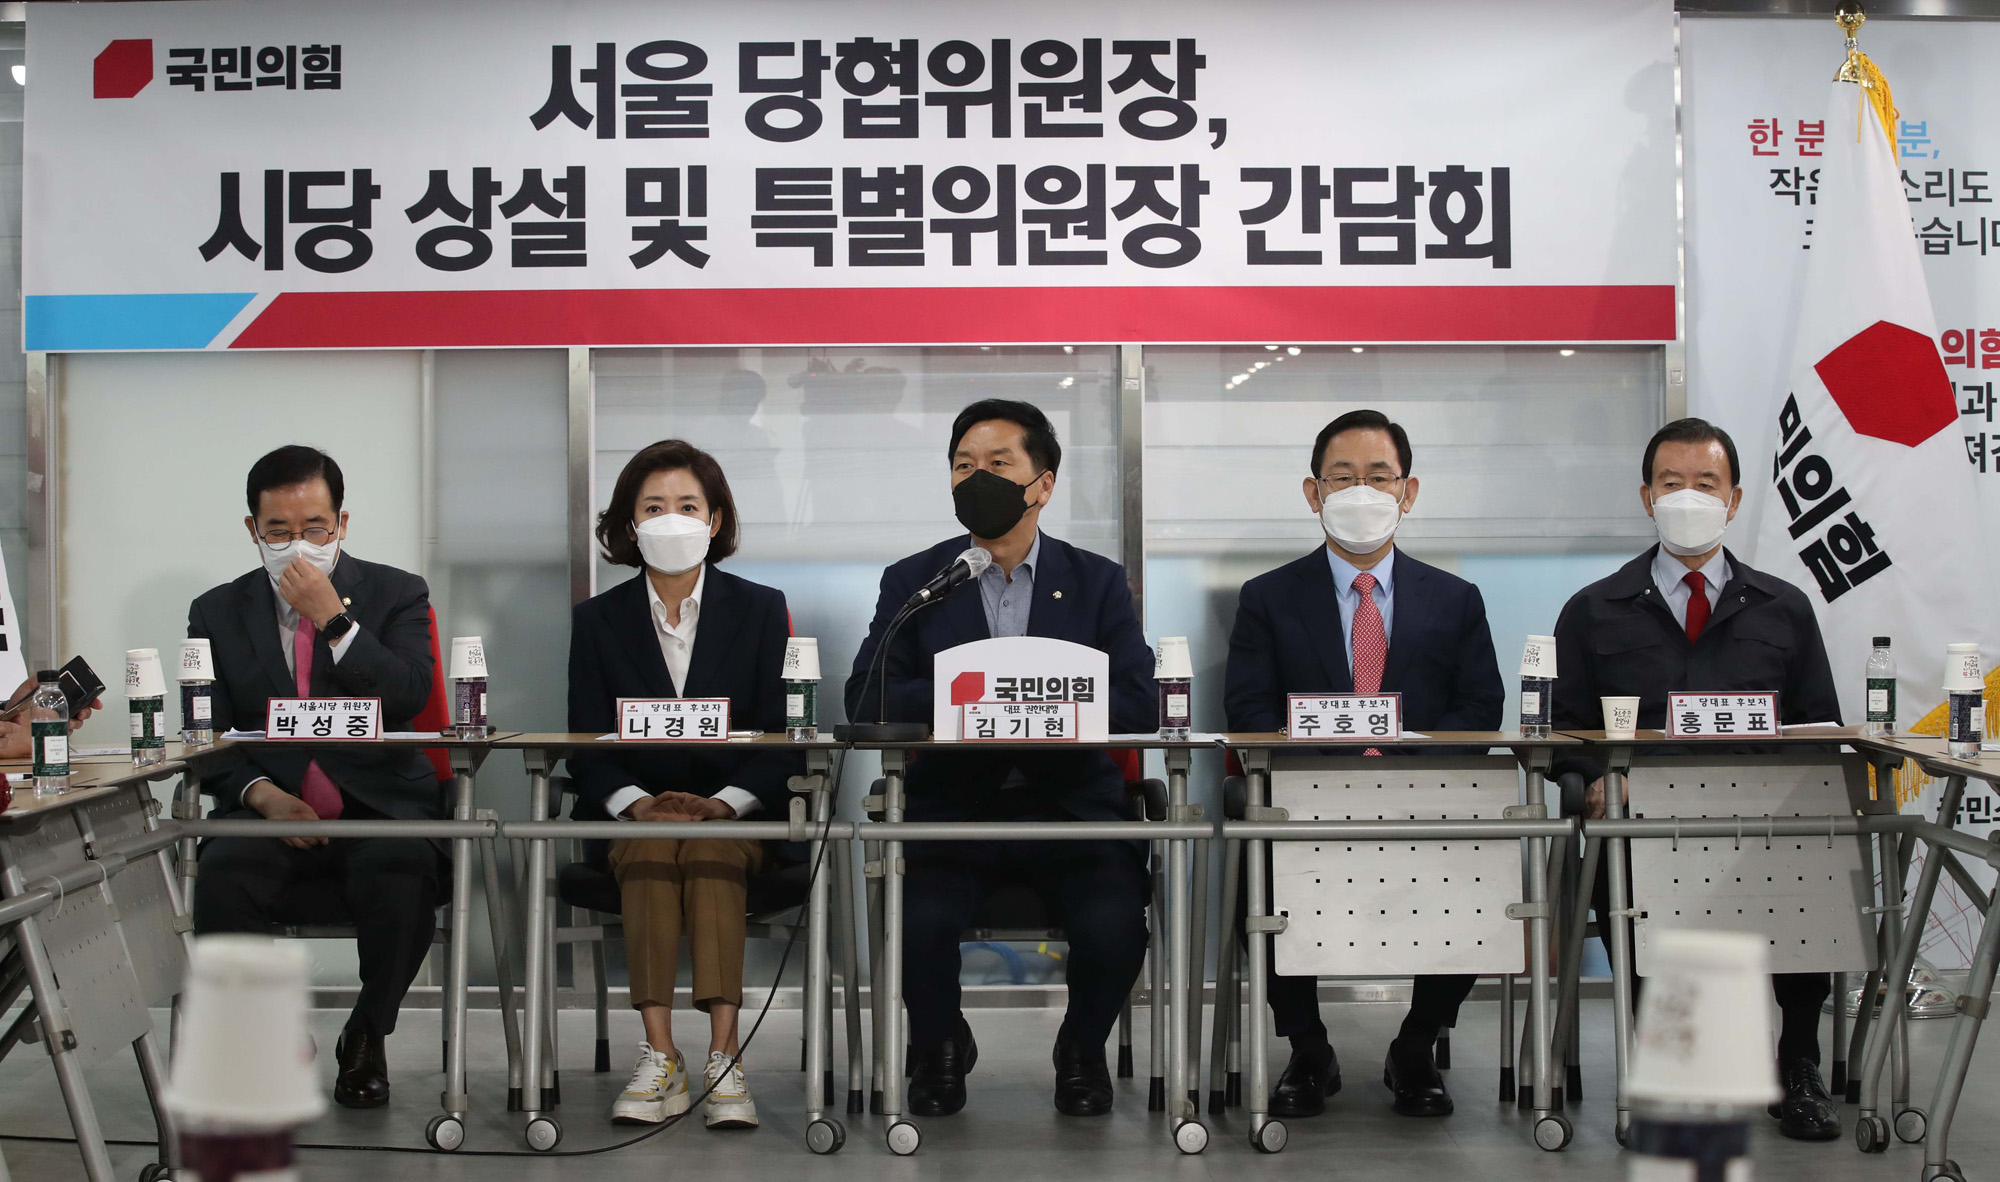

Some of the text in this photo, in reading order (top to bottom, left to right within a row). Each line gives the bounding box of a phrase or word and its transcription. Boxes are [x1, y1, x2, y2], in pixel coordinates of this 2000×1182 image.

[166, 44, 341, 91] 국민의힘
[530, 37, 1226, 149] 서울 당협위원장,
[1748, 119, 1782, 156] 한
[1898, 121, 1940, 159] 분,
[199, 164, 1511, 273] 시당 상설 및 특별위원장 간담회
[995, 677, 1093, 702] 국민의힘
[298, 701, 372, 712] 서울시당 위원장
[651, 703, 721, 713] 당대표 후보자
[1003, 704, 1059, 715] 대표 권한대행
[1319, 699, 1389, 710] 당대표 후보자
[1698, 697, 1767, 708] 당대표 후보자
[277, 716, 369, 736] 박성중
[630, 717, 718, 737] 나경원
[976, 718, 1063, 738] 김기현
[1299, 714, 1388, 736] 주호영
[1680, 712, 1768, 733] 홍문표
